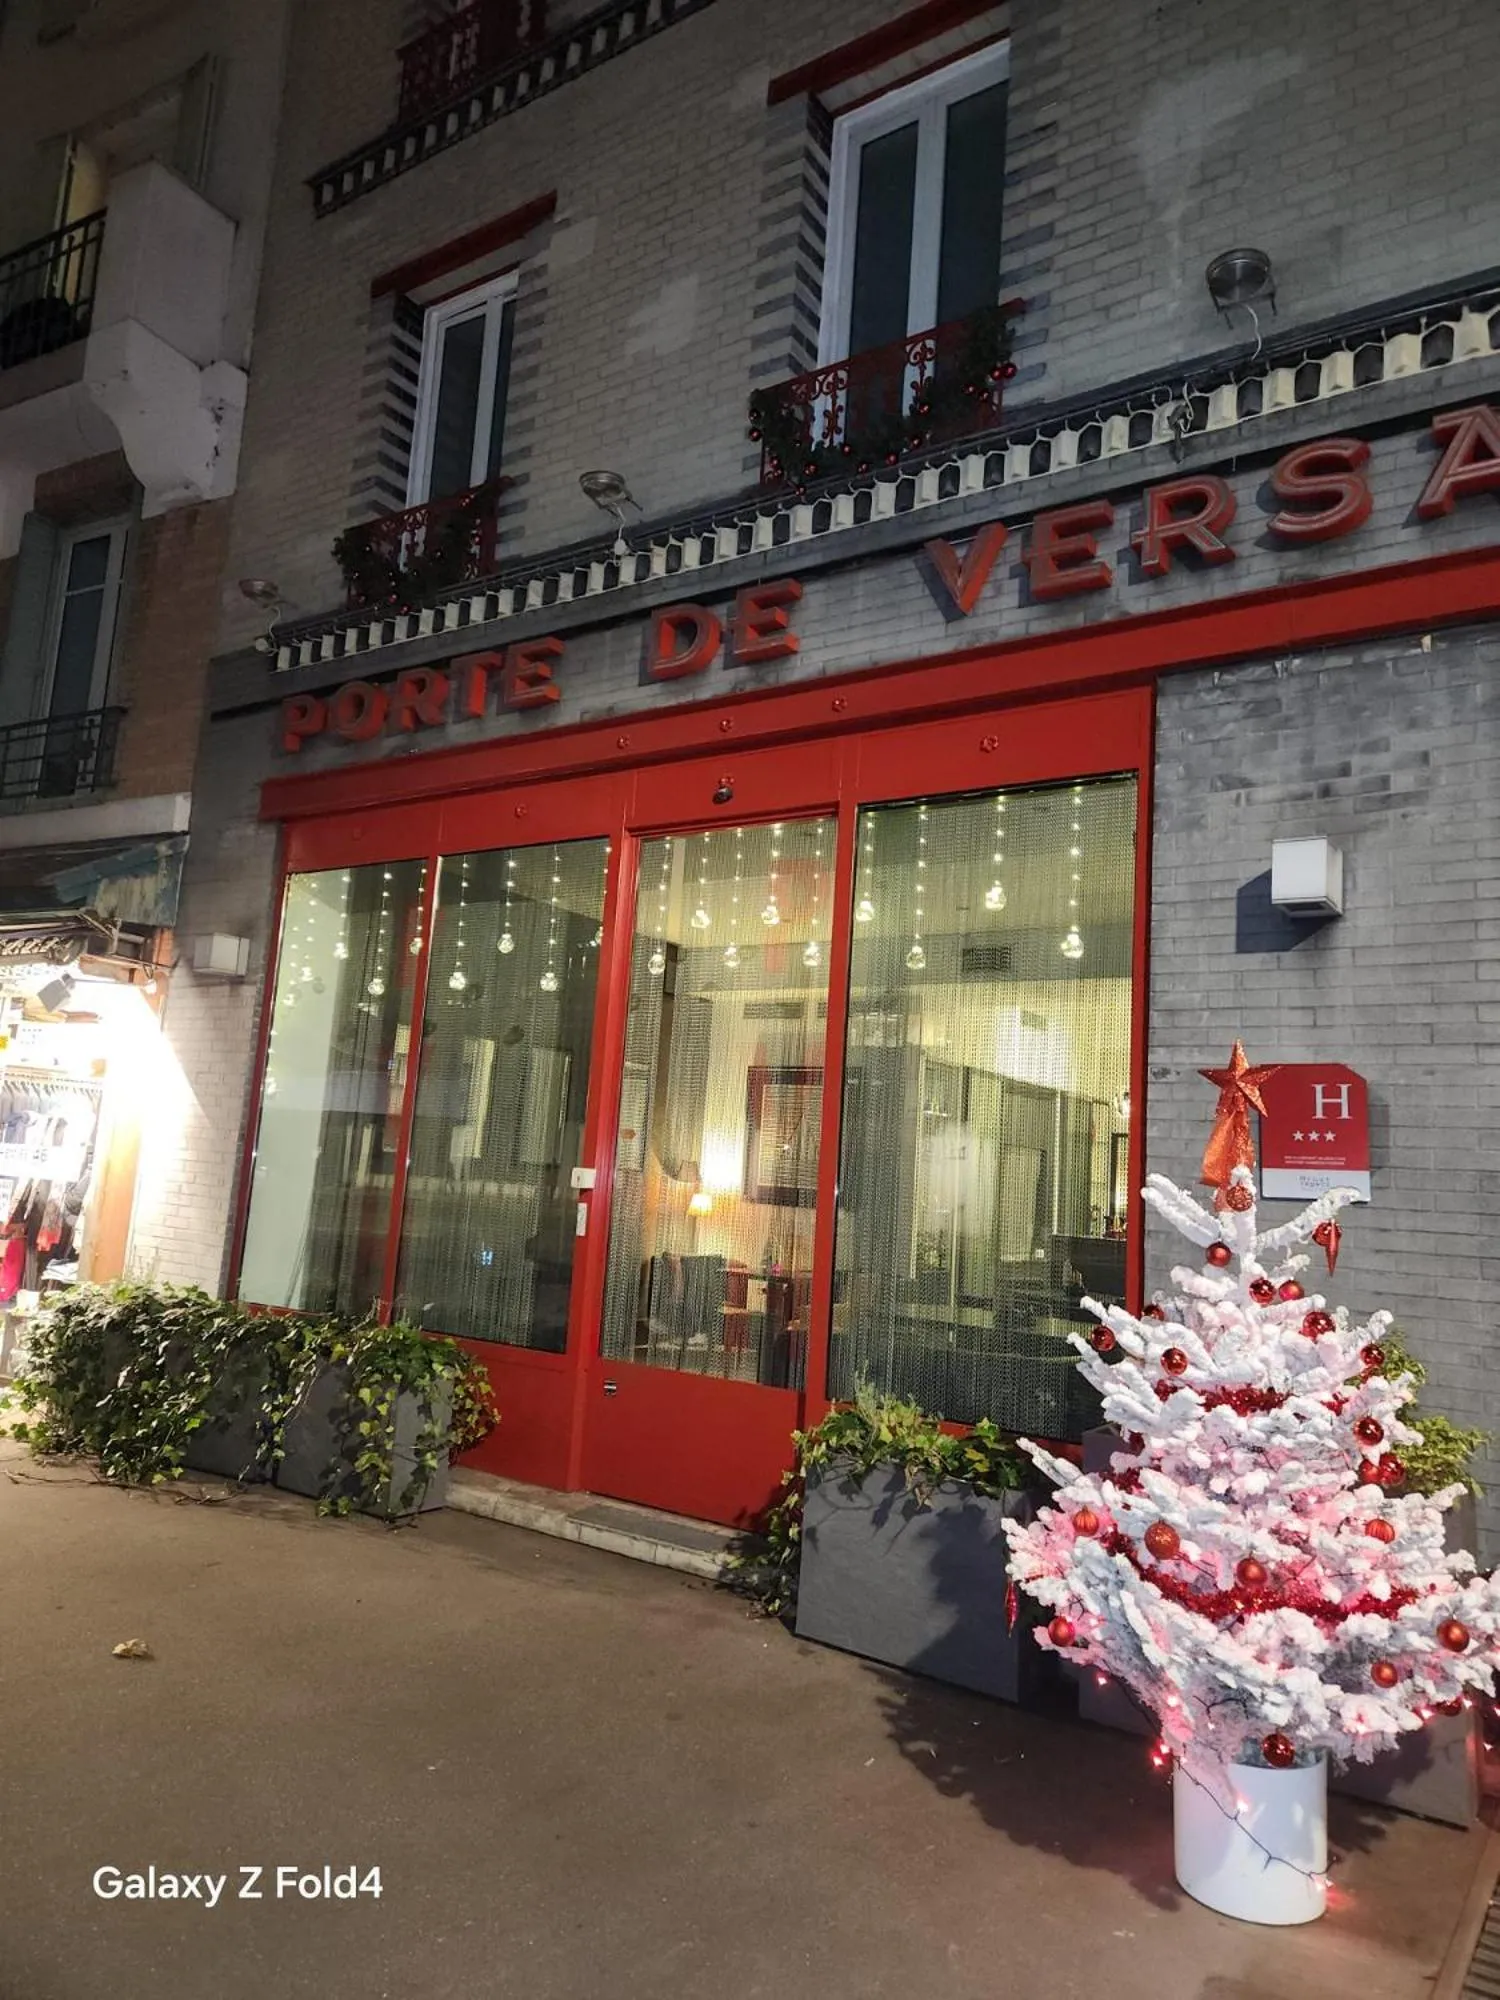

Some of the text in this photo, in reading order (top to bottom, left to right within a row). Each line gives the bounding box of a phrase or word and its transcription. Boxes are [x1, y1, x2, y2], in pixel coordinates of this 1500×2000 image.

[281, 636, 564, 753] PORTE
[645, 578, 804, 681] DE
[1311, 1083, 1353, 1120] H
